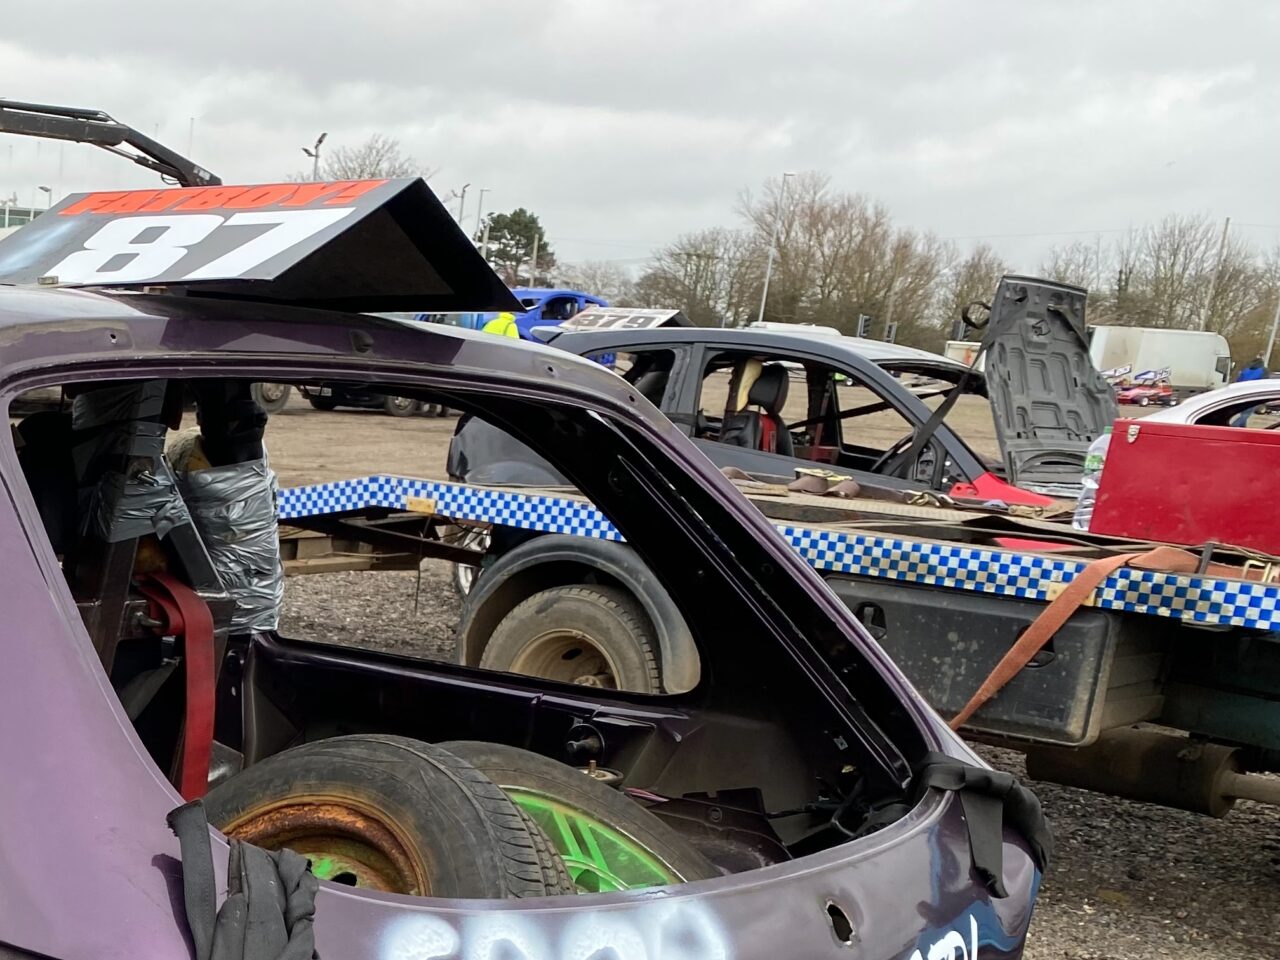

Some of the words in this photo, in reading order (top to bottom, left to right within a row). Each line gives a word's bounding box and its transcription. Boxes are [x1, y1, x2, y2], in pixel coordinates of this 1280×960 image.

[58, 179, 389, 216] FATBOY!
[44, 207, 357, 285] 87
[572, 313, 657, 329] 379
